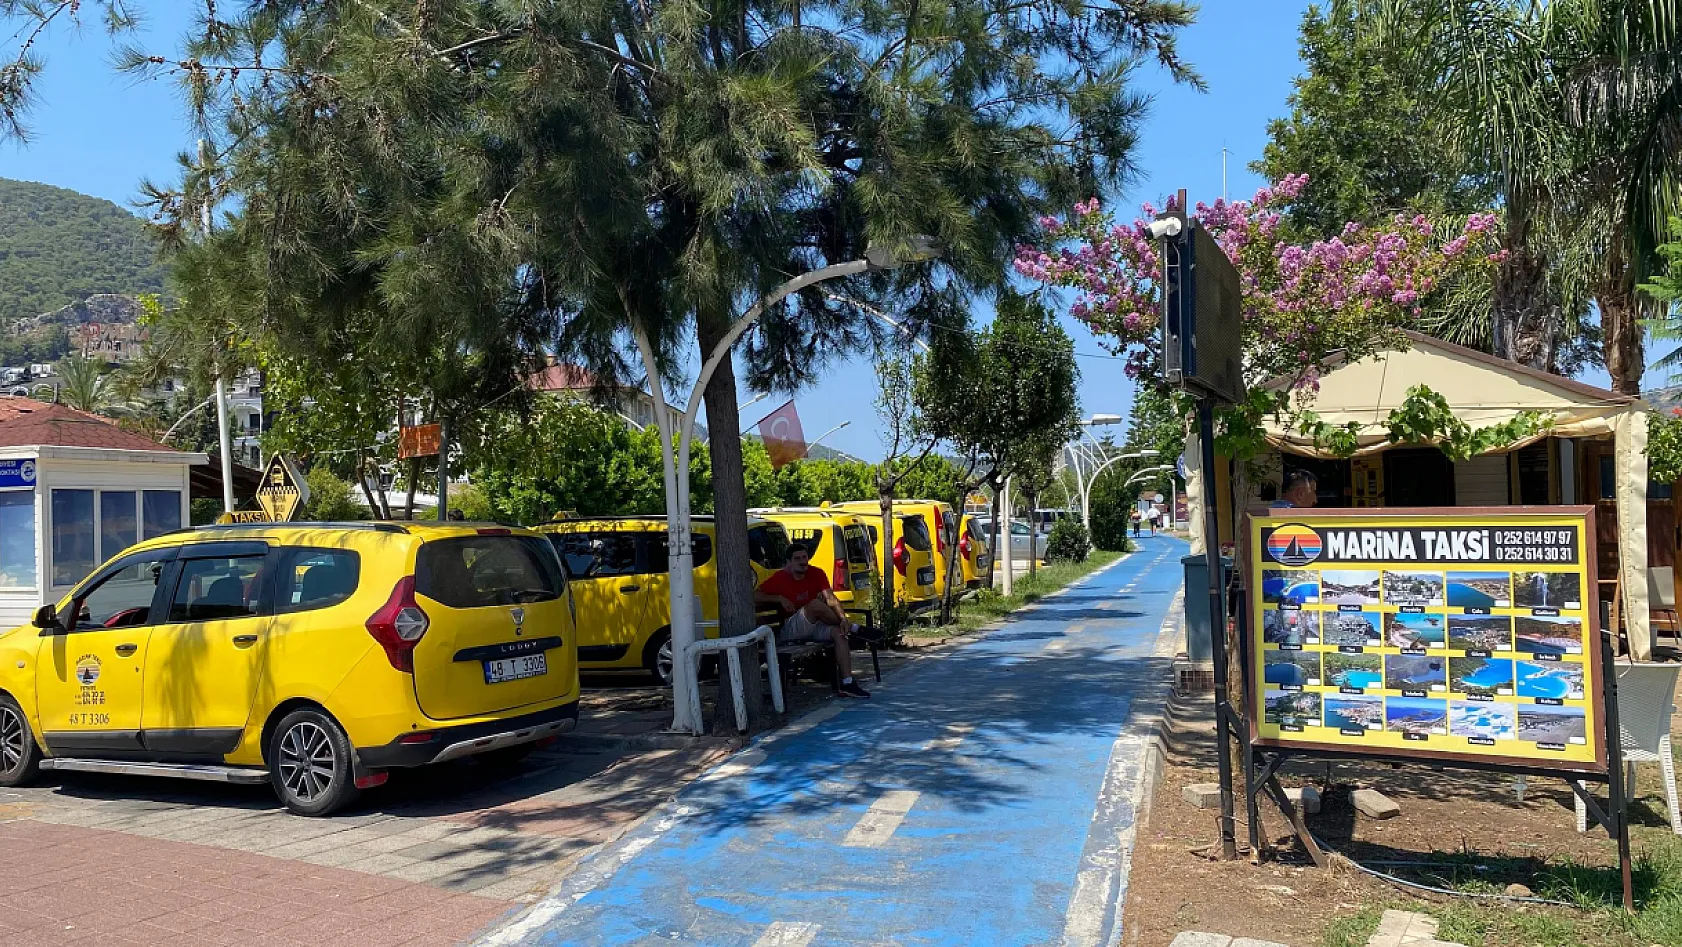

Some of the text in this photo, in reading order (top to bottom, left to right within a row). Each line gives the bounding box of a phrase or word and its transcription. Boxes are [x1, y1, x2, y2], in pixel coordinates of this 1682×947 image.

[1495, 531, 1571, 545] 0 252 614 97 97
[1496, 548, 1572, 560] 0 252 614 30 31
[491, 655, 544, 676] 48 T 3306
[69, 713, 110, 725] 48 T 3306
